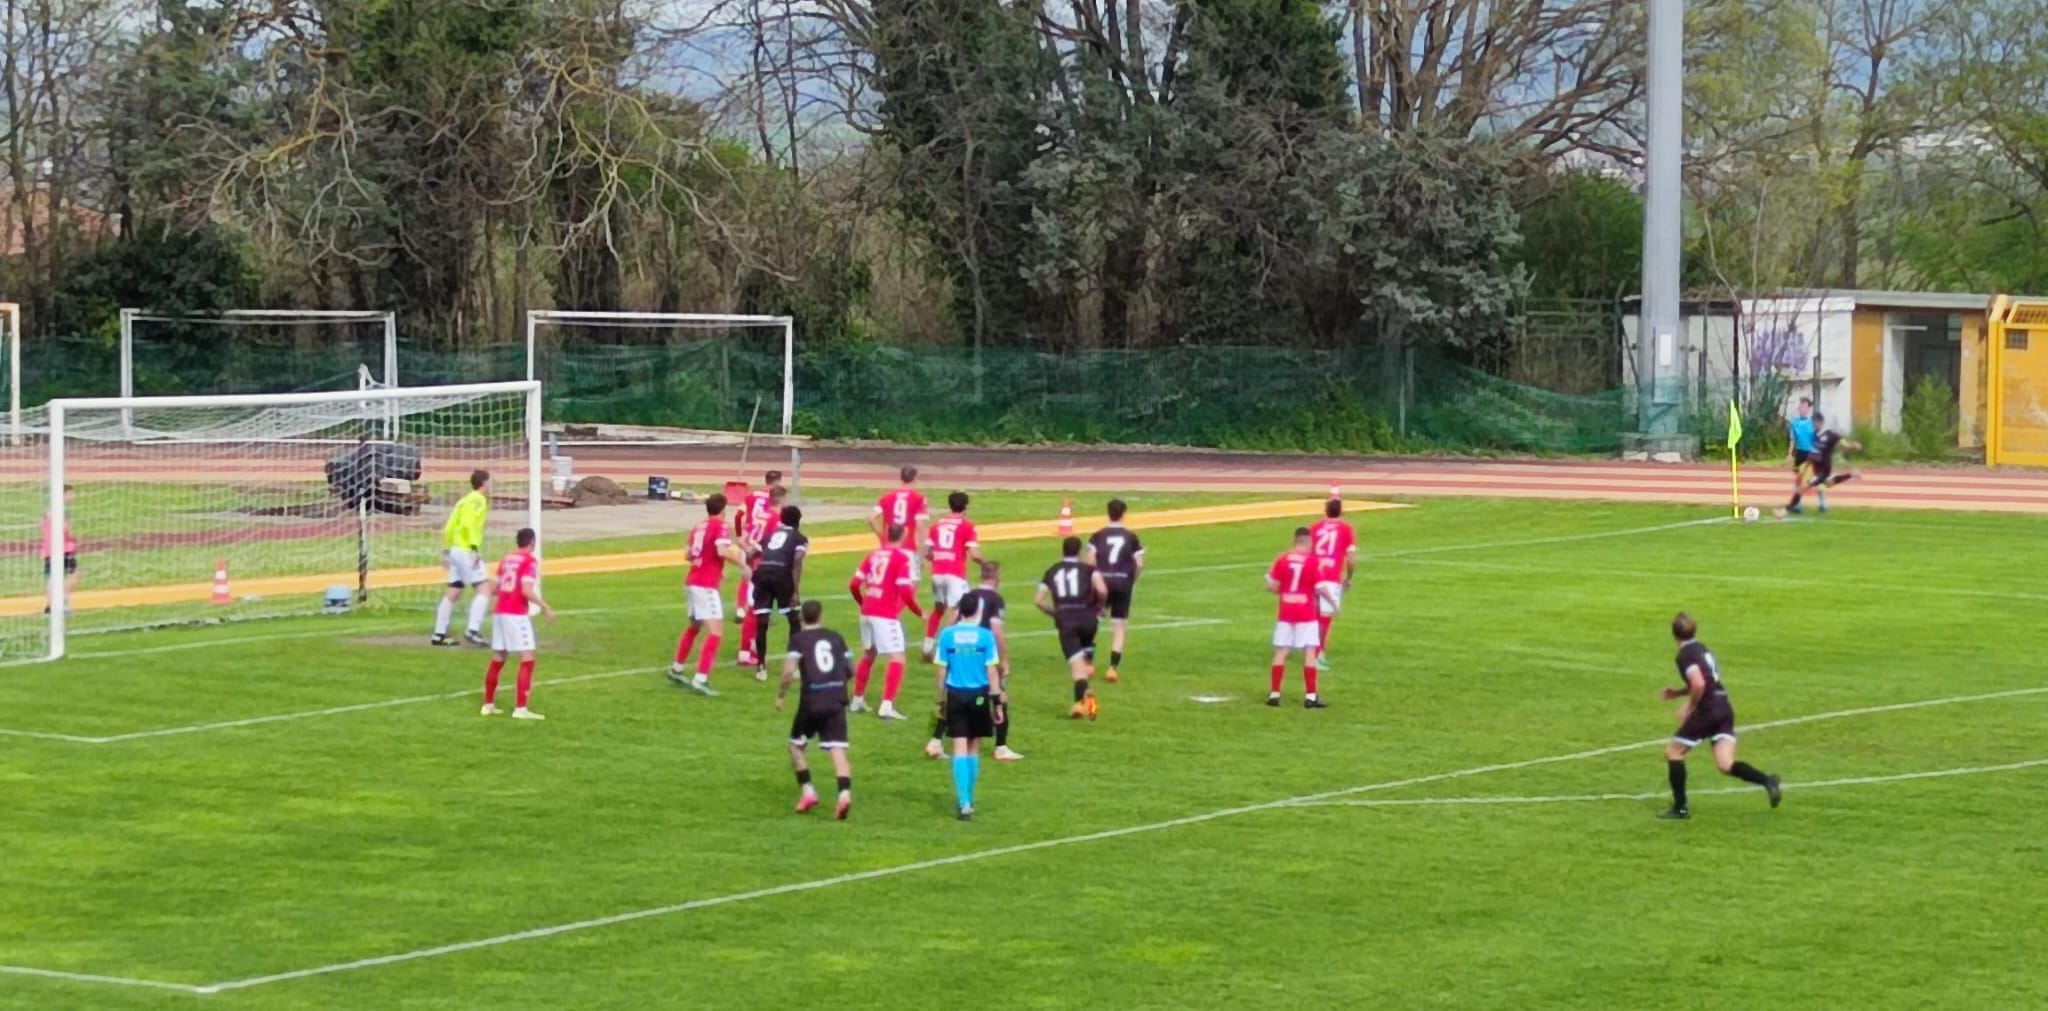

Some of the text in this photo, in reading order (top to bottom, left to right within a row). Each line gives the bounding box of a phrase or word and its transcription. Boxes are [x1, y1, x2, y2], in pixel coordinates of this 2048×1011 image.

[893, 497, 908, 525] 9
[767, 530, 788, 550] 9
[937, 524, 958, 549] 16
[1106, 536, 1124, 564] 7
[1314, 529, 1338, 556] 21
[1054, 568, 1080, 598] 11
[815, 639, 834, 673] 6
